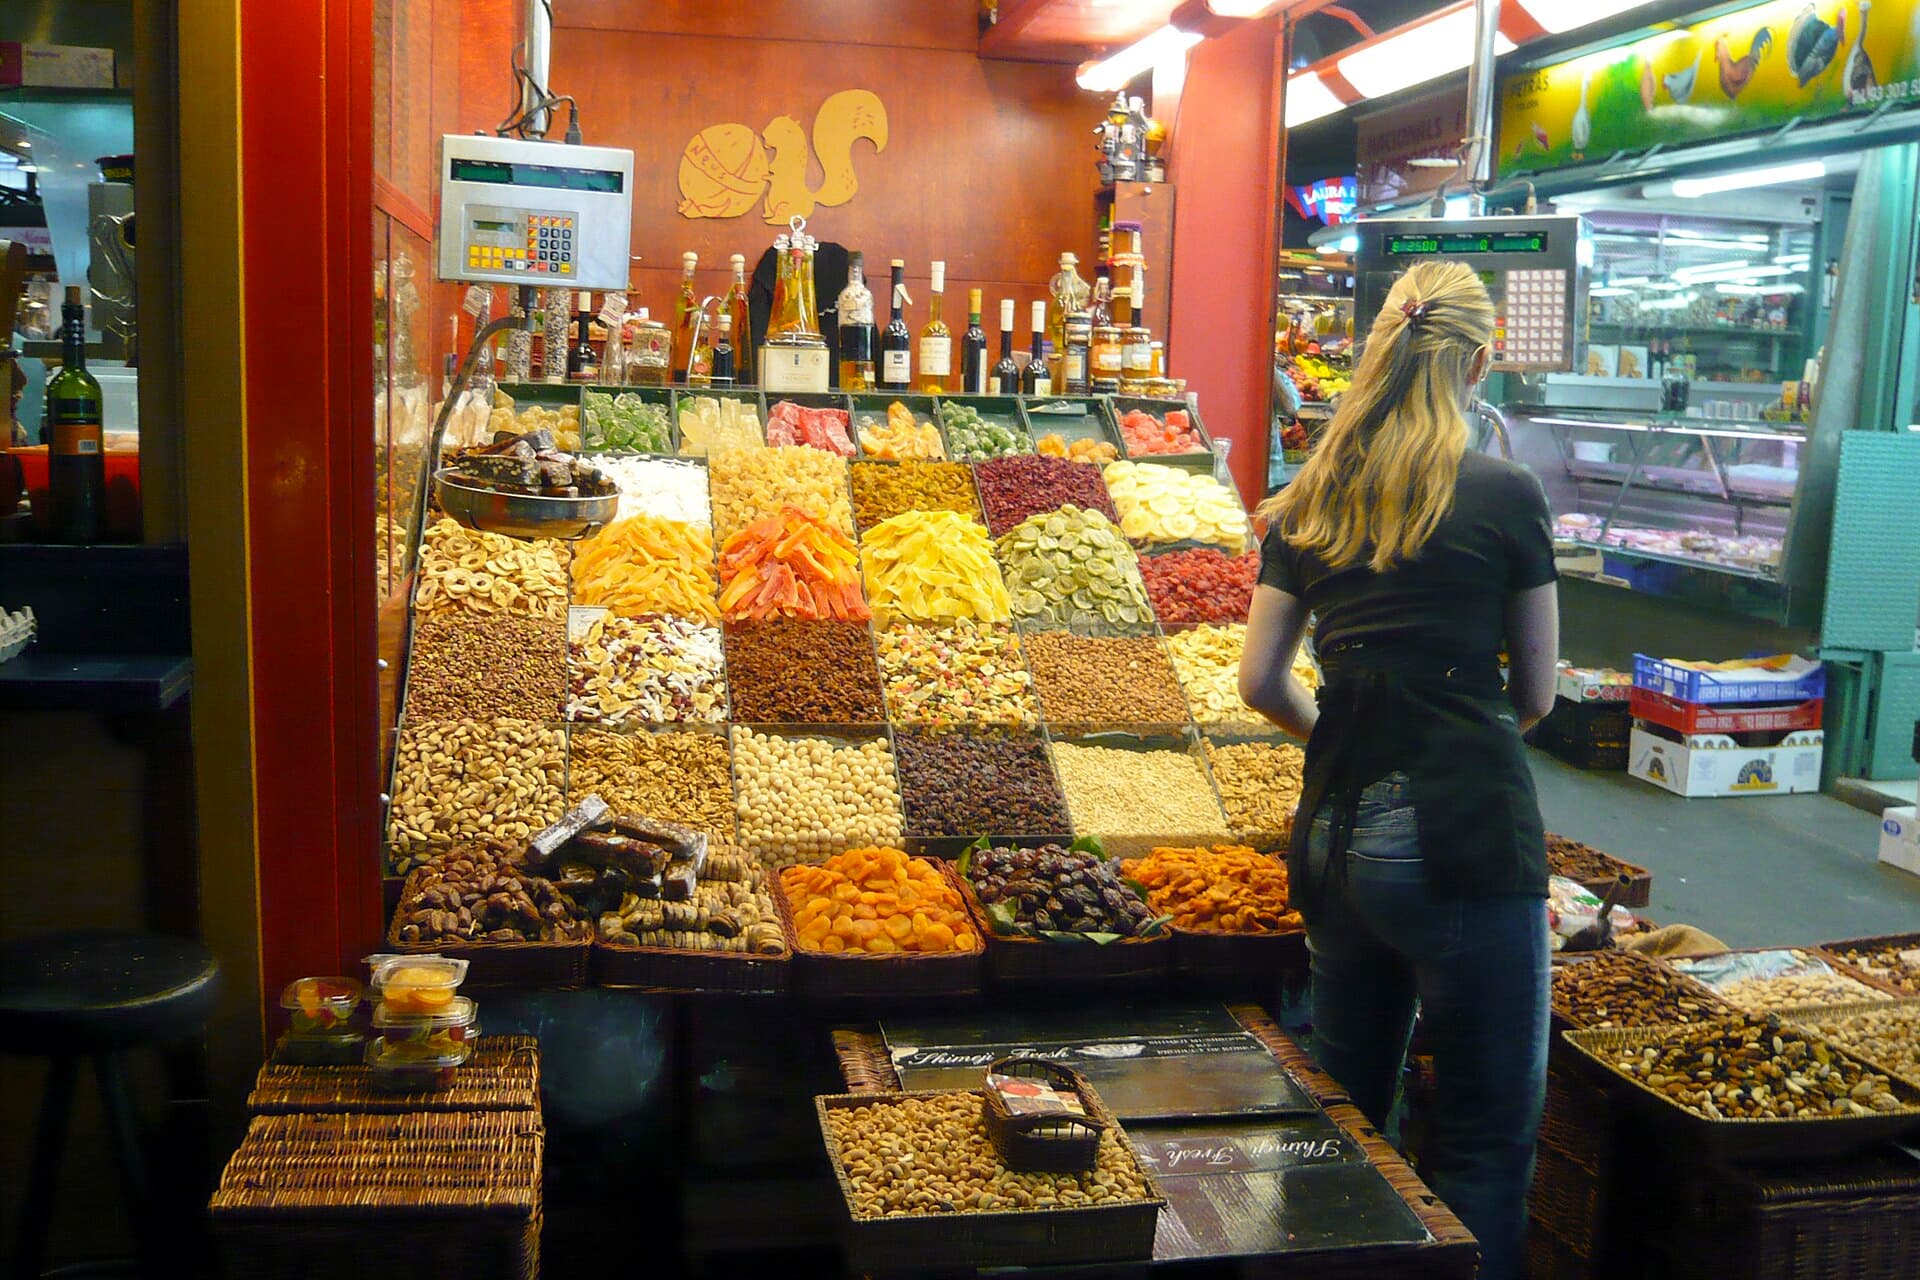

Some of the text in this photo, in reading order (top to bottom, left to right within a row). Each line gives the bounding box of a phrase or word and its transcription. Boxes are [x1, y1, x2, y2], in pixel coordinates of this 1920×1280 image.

[690, 145, 728, 180] Neus
[908, 1047, 1070, 1066] Shimeji Fresh
[1166, 1139, 1342, 1168] Shimeji Fresh
